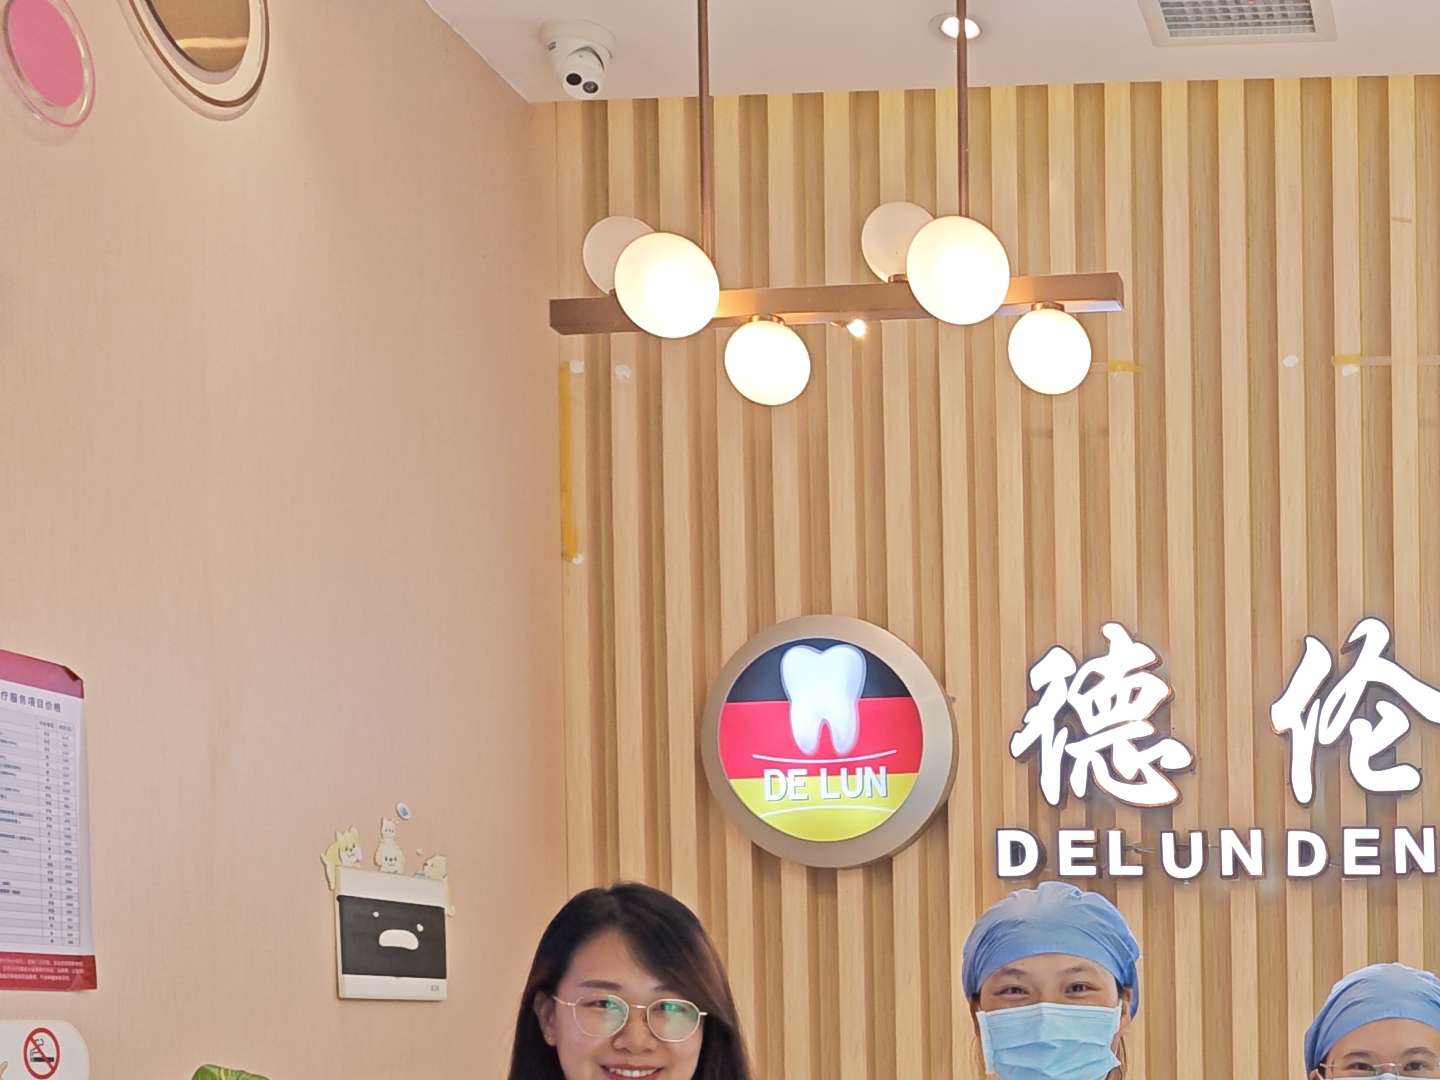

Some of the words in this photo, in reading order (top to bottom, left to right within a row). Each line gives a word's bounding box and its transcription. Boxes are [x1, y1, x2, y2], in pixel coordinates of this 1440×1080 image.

[763, 768, 809, 802] DE
[820, 766, 888, 799] LUN
[995, 827, 1266, 881] DELUN
